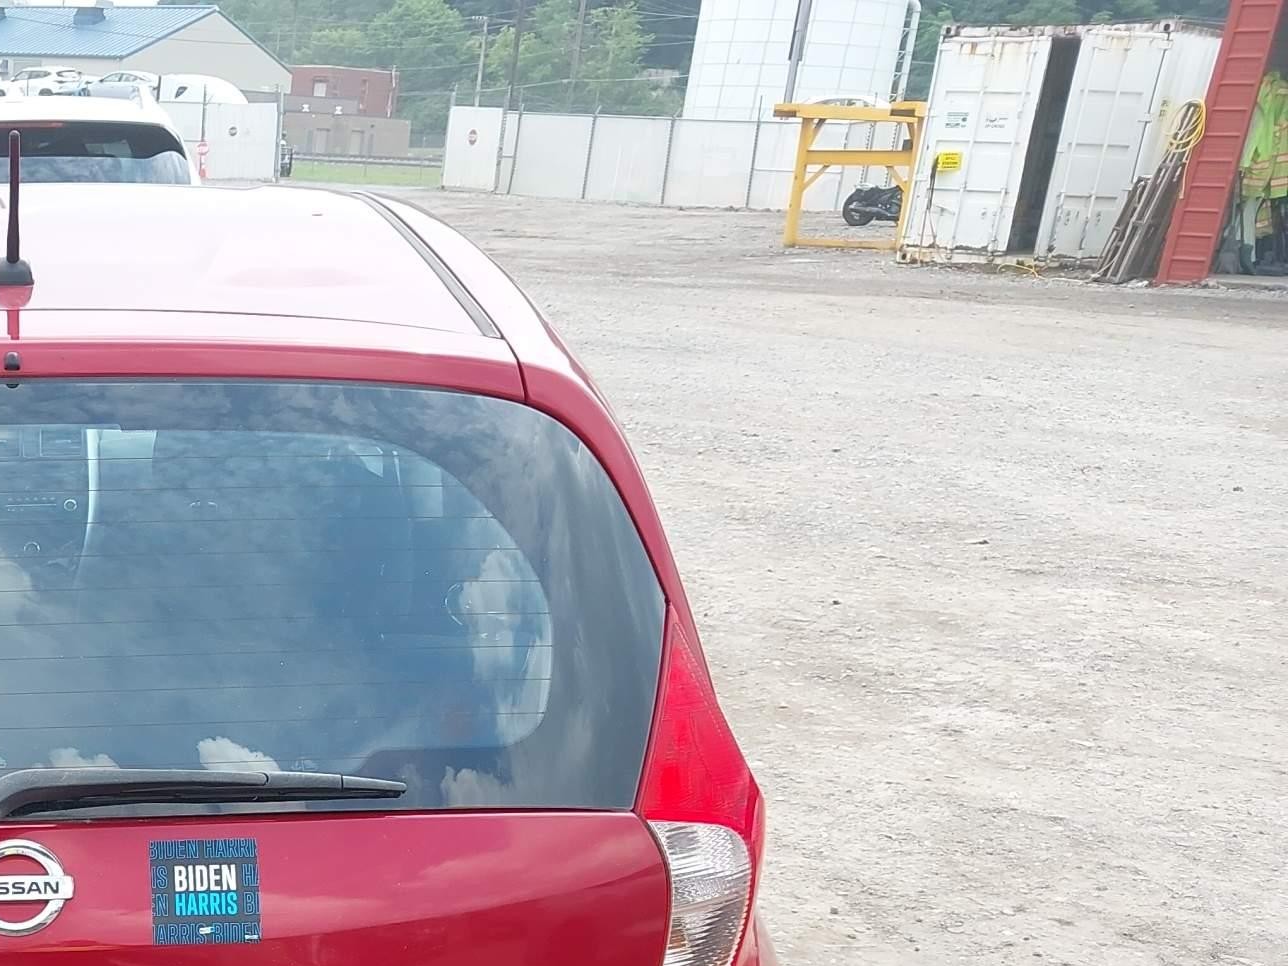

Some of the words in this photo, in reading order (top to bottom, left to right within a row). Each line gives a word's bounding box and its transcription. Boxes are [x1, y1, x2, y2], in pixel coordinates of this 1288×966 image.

[205, 838, 259, 858] HARRI
[173, 864, 237, 892] BIDEN
[175, 891, 238, 916] HARRIS
